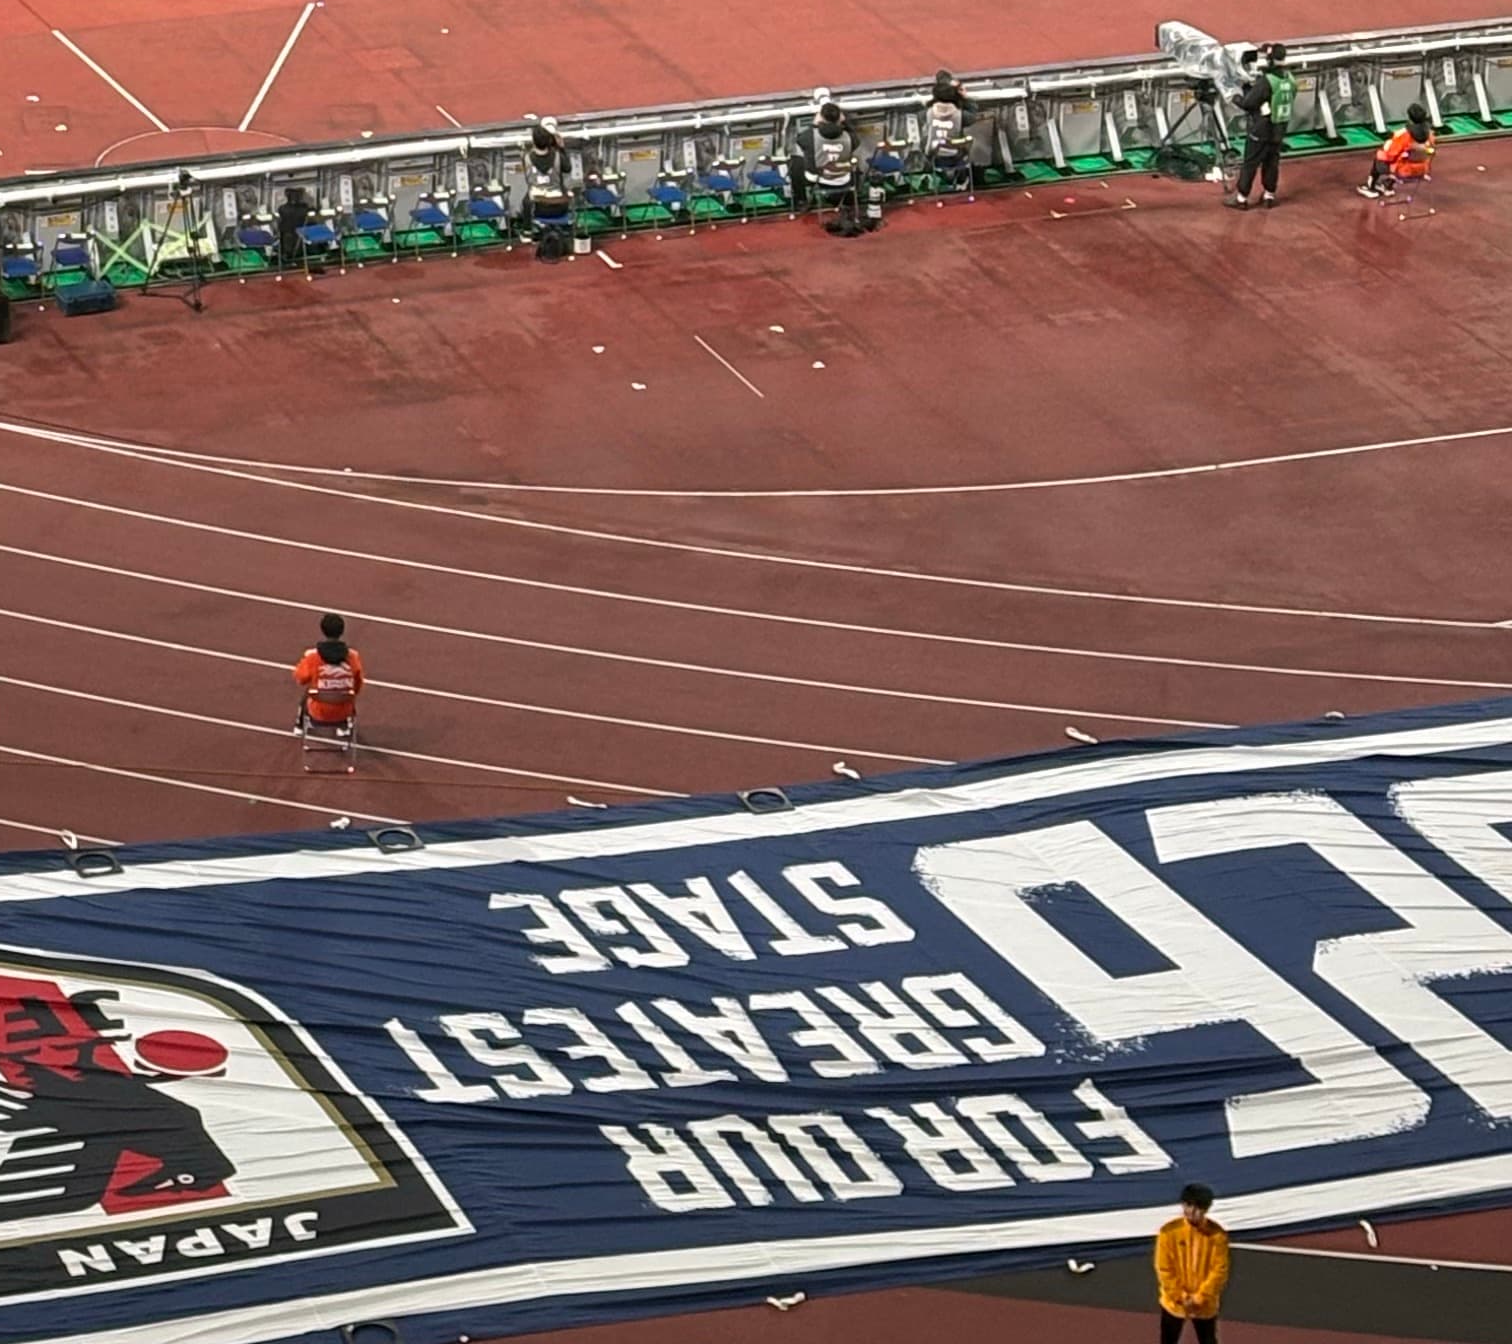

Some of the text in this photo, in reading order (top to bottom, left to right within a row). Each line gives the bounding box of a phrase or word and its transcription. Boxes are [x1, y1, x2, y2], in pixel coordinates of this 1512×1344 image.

[488, 861, 917, 974] STAGE
[382, 971, 1046, 1104] GREATEST
[598, 1078, 1177, 1213] FOR OUR
[56, 1212, 319, 1278] JAPAN
